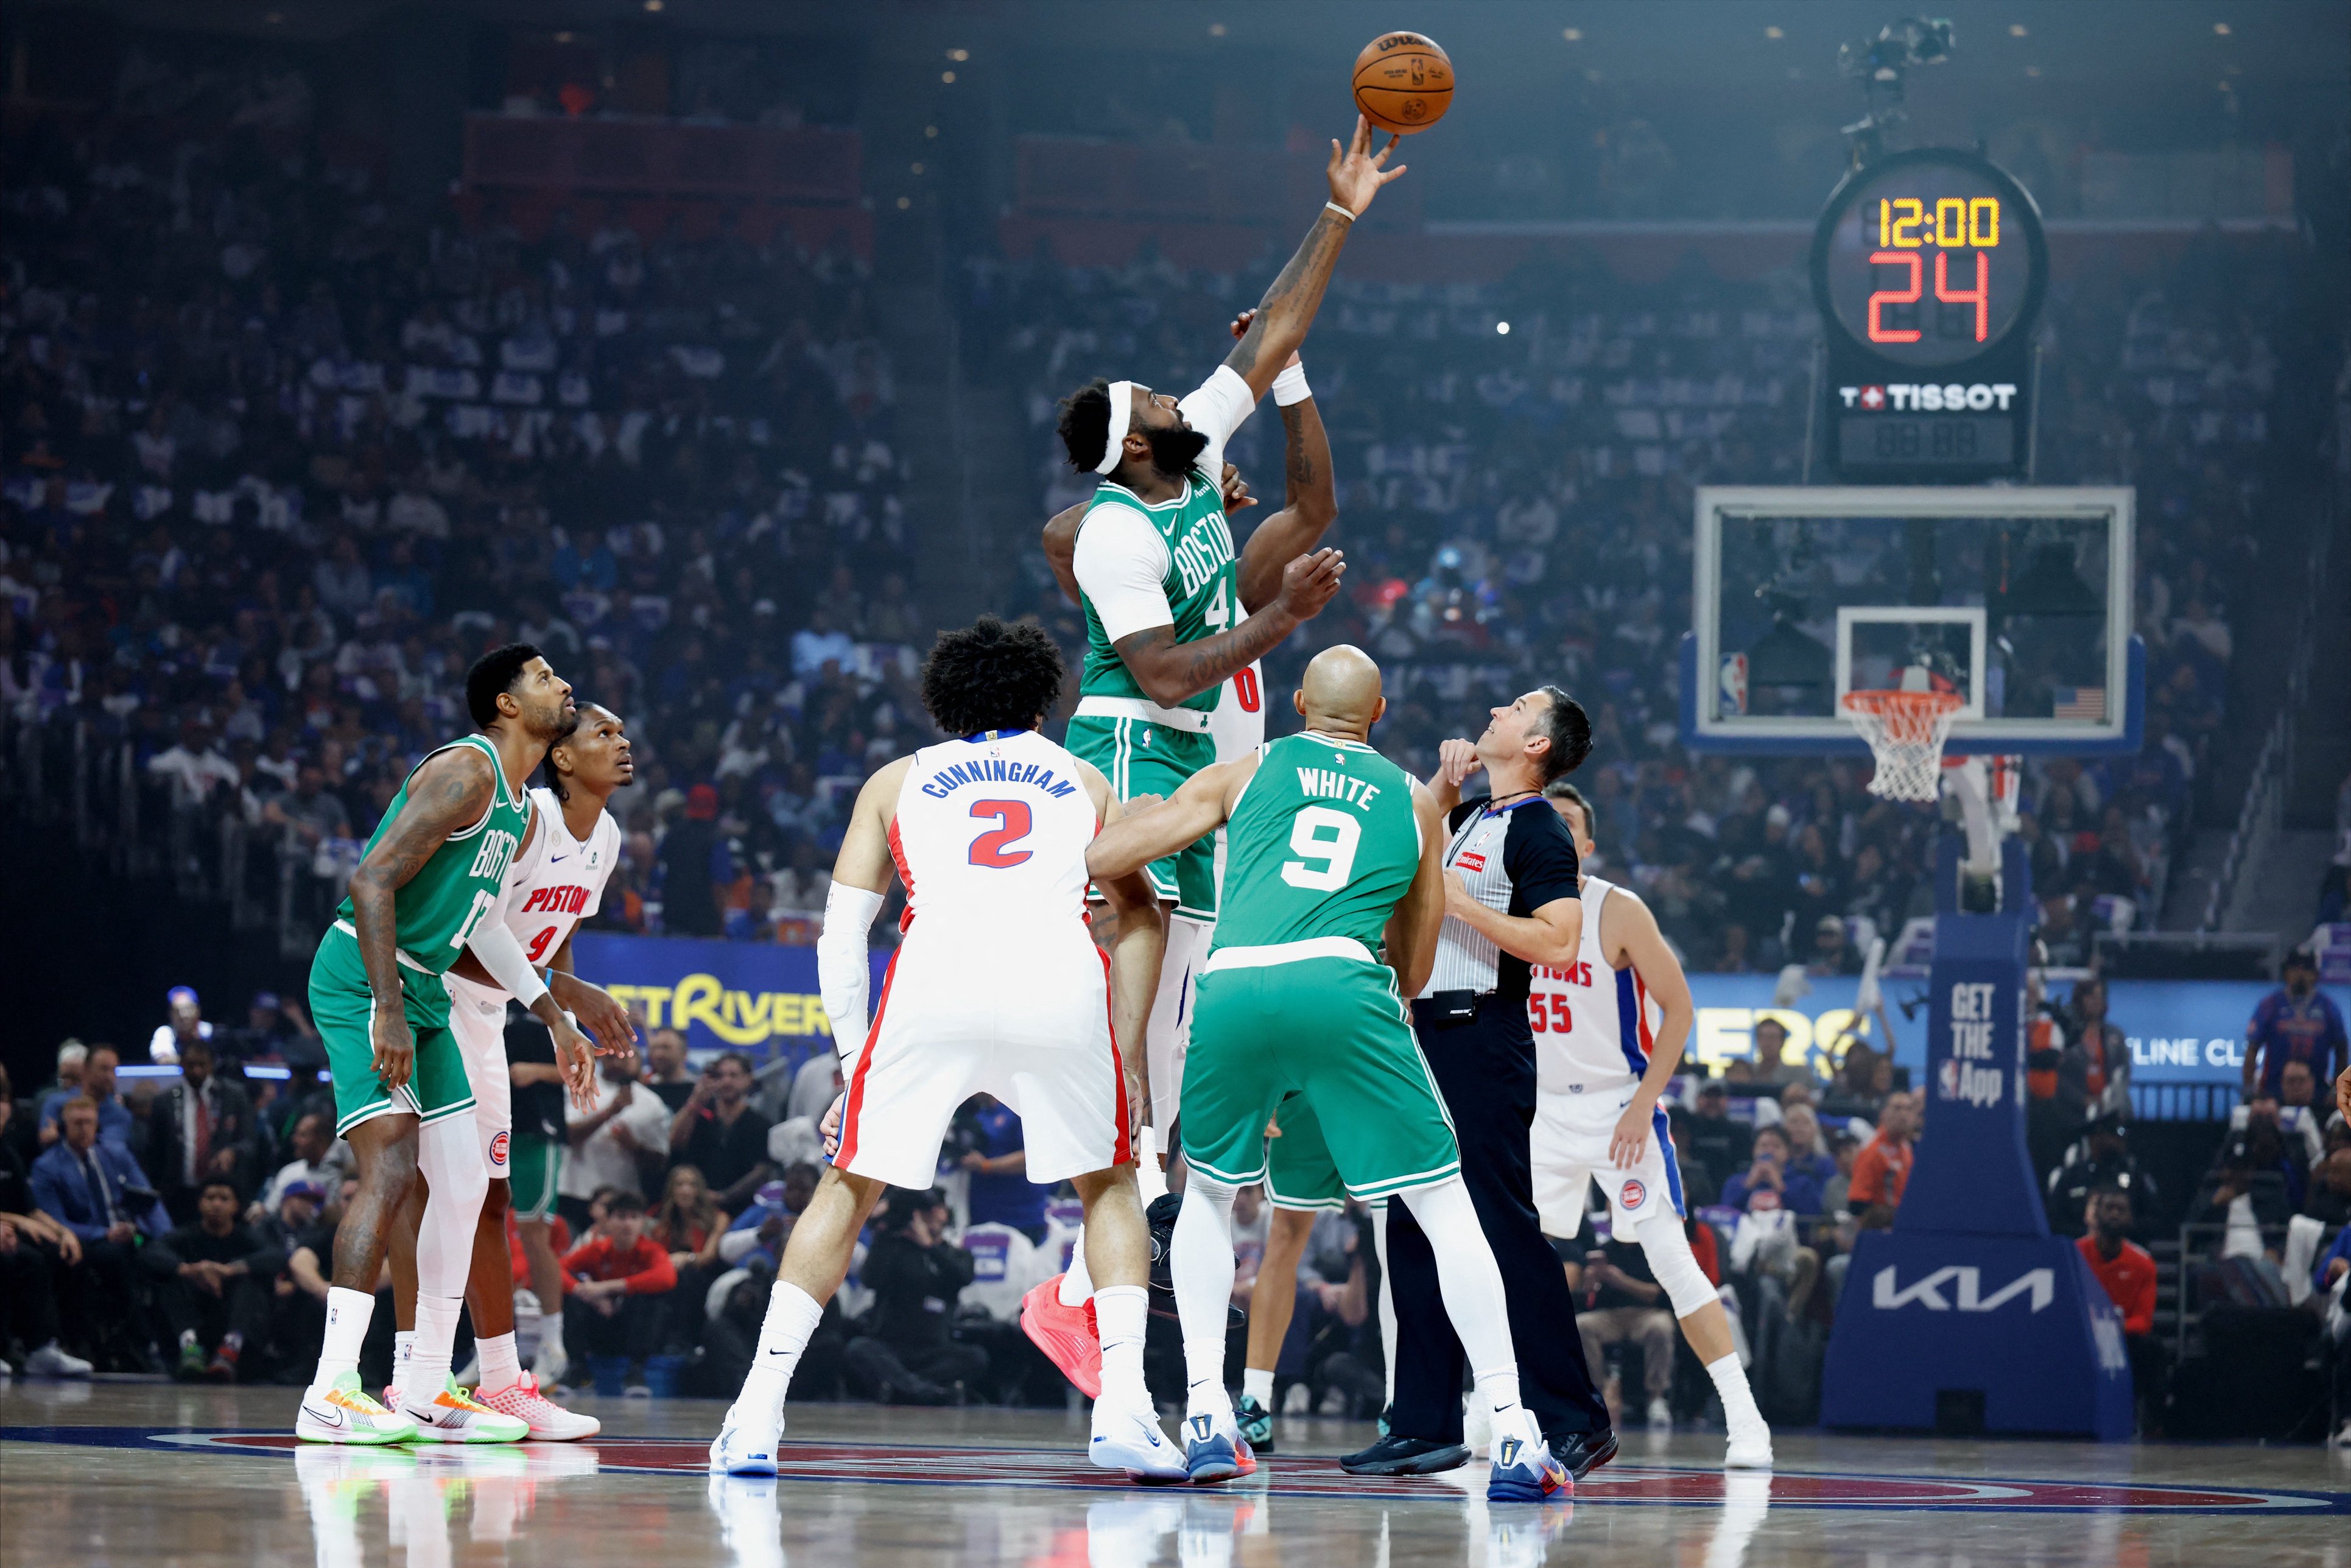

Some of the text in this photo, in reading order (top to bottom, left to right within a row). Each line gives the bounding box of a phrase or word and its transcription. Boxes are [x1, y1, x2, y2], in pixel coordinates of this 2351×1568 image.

[1880, 198, 2000, 247] 12:00
[1868, 251, 1989, 342] 24
[1887, 383, 2017, 411] TISSOT
[1204, 576, 1230, 635] 4
[921, 759, 1077, 799] CUNNINGHAM
[1296, 766, 1381, 812] WHITE
[968, 799, 1034, 869] 2
[1280, 805, 1362, 893] 9
[1457, 854, 1484, 869] Emirates
[521, 885, 592, 916] PISTON
[526, 926, 558, 962] 9
[1530, 993, 1572, 1033] 55
[1951, 982, 1997, 1020] GET
[1950, 1021, 1995, 1060] THE
[2124, 1037, 2199, 1066] LINE
[1958, 1060, 2003, 1102] App
[1872, 1264, 2054, 1313] KIA
